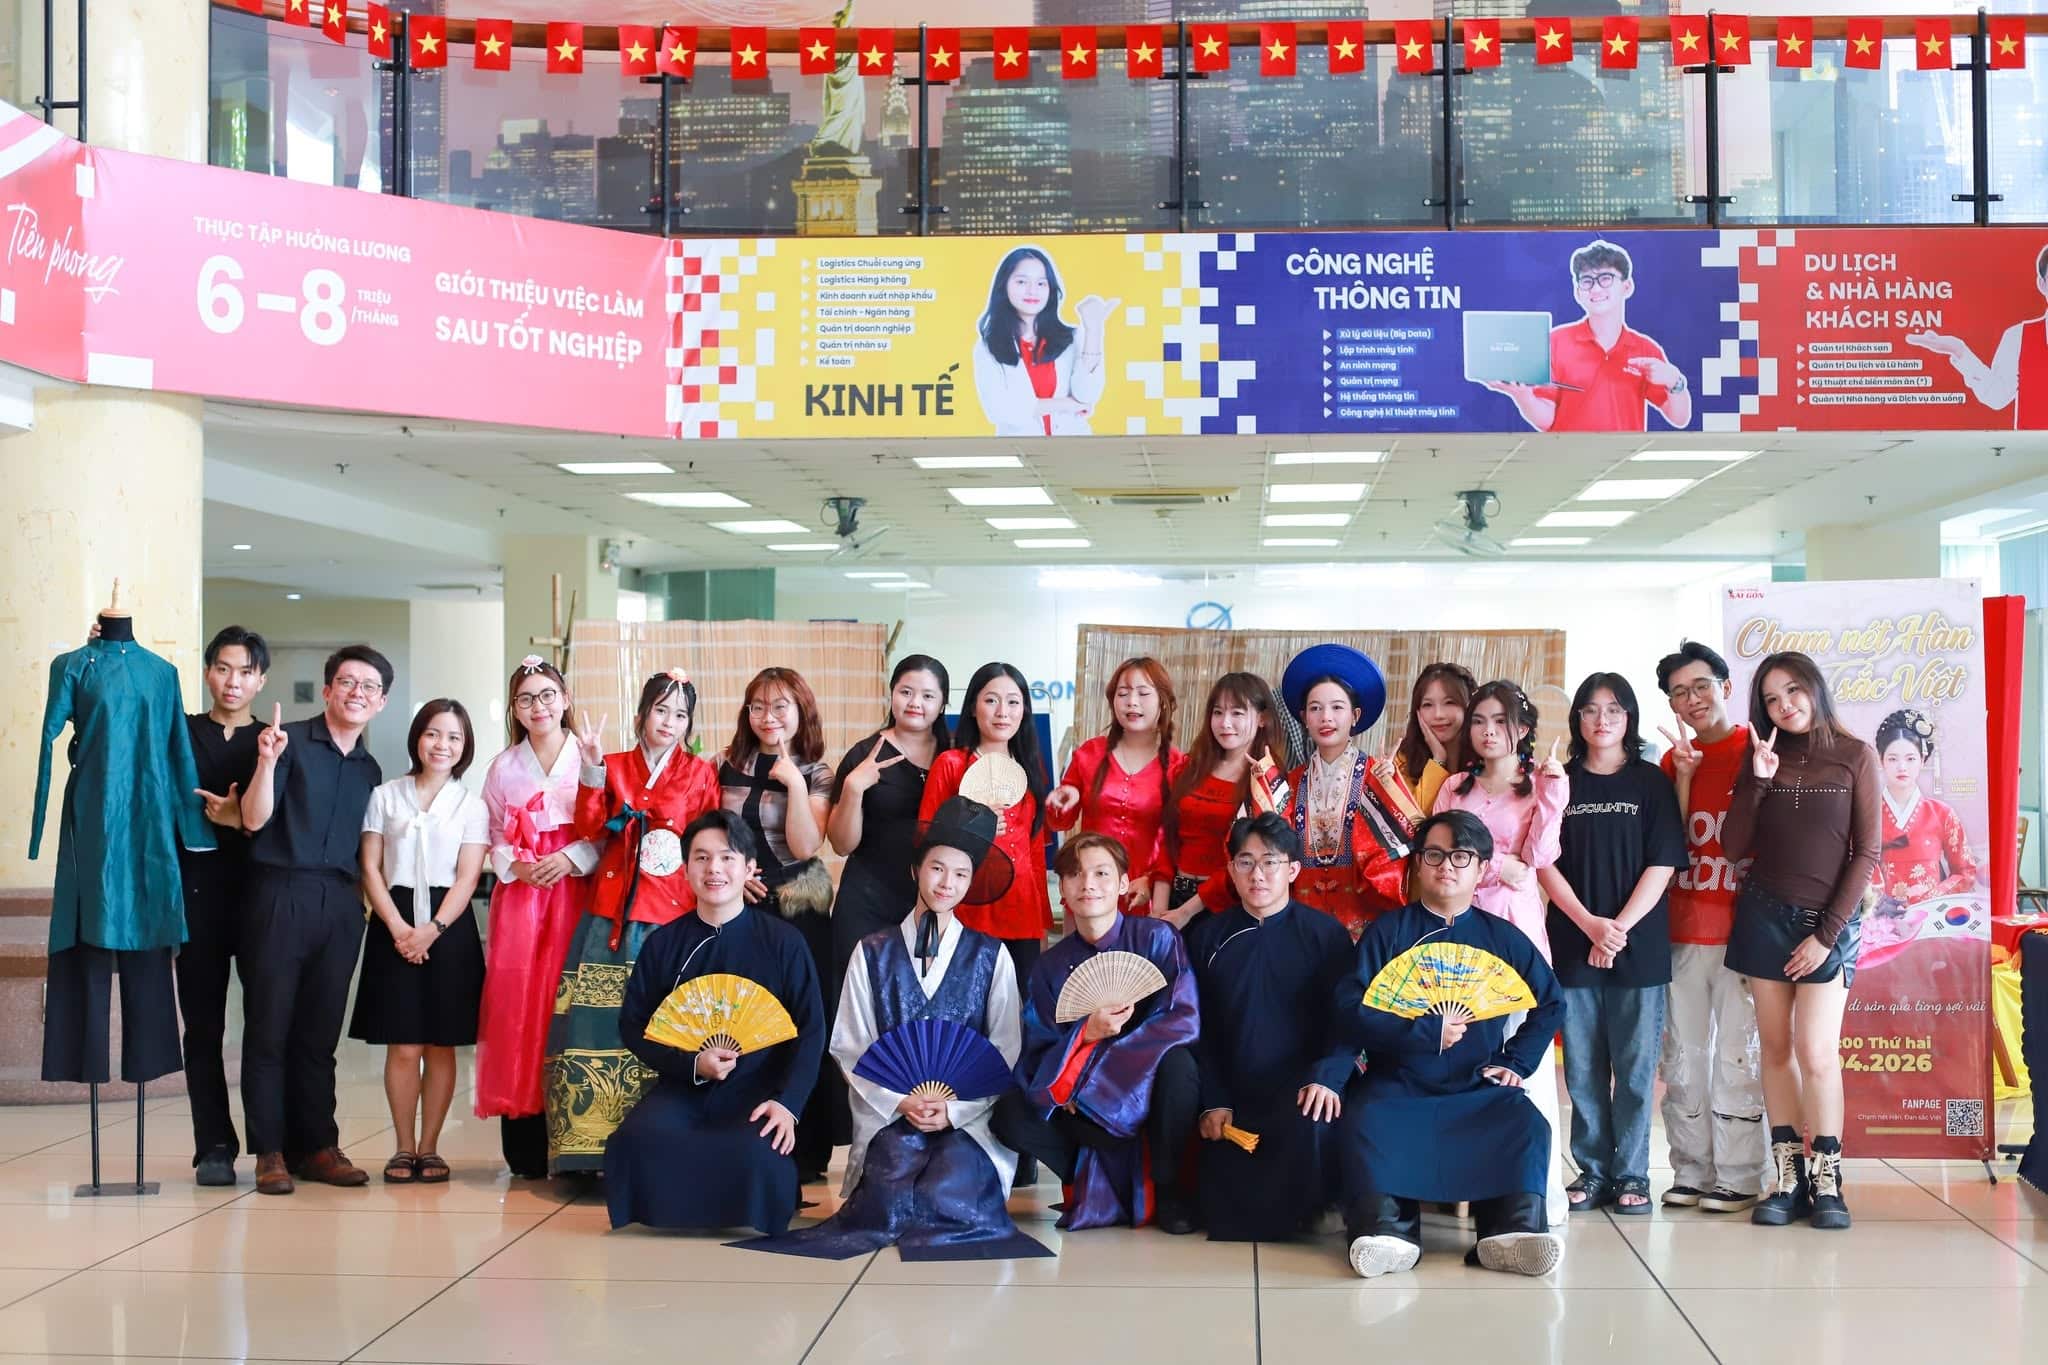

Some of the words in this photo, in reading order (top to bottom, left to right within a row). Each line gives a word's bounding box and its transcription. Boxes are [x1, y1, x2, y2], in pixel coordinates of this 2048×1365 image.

[193, 216, 243, 241] THỰC
[248, 221, 282, 248] TẬP
[286, 229, 350, 254] HƯỞNG
[353, 239, 412, 263] LƯƠNG
[45, 226, 124, 302] phong
[820, 259, 855, 269] Logistics
[883, 260, 903, 269] cung
[1286, 247, 1361, 275] CÔNG
[1366, 246, 1434, 282] NGHỆ
[1804, 254, 1836, 272] DU
[1842, 253, 1897, 277] LỊCH
[820, 275, 855, 285] Logistics
[435, 269, 484, 297] GIỚI
[489, 278, 549, 310] THIỆU
[553, 286, 599, 316] VIỆC
[604, 290, 644, 318] LÀM
[820, 291, 838, 299] Kinh
[840, 291, 866, 299] doanh
[1313, 279, 1410, 310] THÔNG
[1414, 286, 1461, 309] TIN
[1806, 282, 1825, 300] &
[1829, 276, 1880, 300] NHÀ
[1885, 276, 1953, 300] HÀNG
[357, 289, 391, 307] TRIỆU
[351, 307, 399, 327] /THÁNG
[888, 308, 910, 318] hàng
[1806, 305, 1889, 329] KHÁCH
[1895, 310, 1942, 334] SẠN
[854, 324, 880, 332] doanh
[882, 324, 911, 334] nghiệp
[1390, 328, 1406, 340] (Big
[1408, 328, 1431, 340] Data)
[435, 316, 488, 345] SAU
[493, 312, 544, 352] TỐT
[549, 331, 642, 369] NGHIỆP
[1846, 344, 1872, 352] Khách
[1340, 361, 1351, 369] An
[1353, 360, 1371, 369] ninh
[1372, 362, 1396, 372] mạng
[1858, 361, 1874, 370] lịch
[805, 384, 903, 416] KINH
[912, 363, 960, 416] TẾ
[1374, 378, 1398, 387] mạng
[1404, 392, 1414, 400] tin
[1899, 395, 1917, 403] Dịch
[1839, 618, 1893, 653] nét
[1896, 611, 1976, 657] Hàn
[1834, 663, 1890, 704] sắc
[1893, 657, 1968, 707] Việt
[1839, 1037, 1864, 1049] :00
[1868, 1036, 1900, 1049] Thứ
[1906, 1036, 1932, 1049] hai
[1902, 1099, 1941, 1109] FANPAGE
